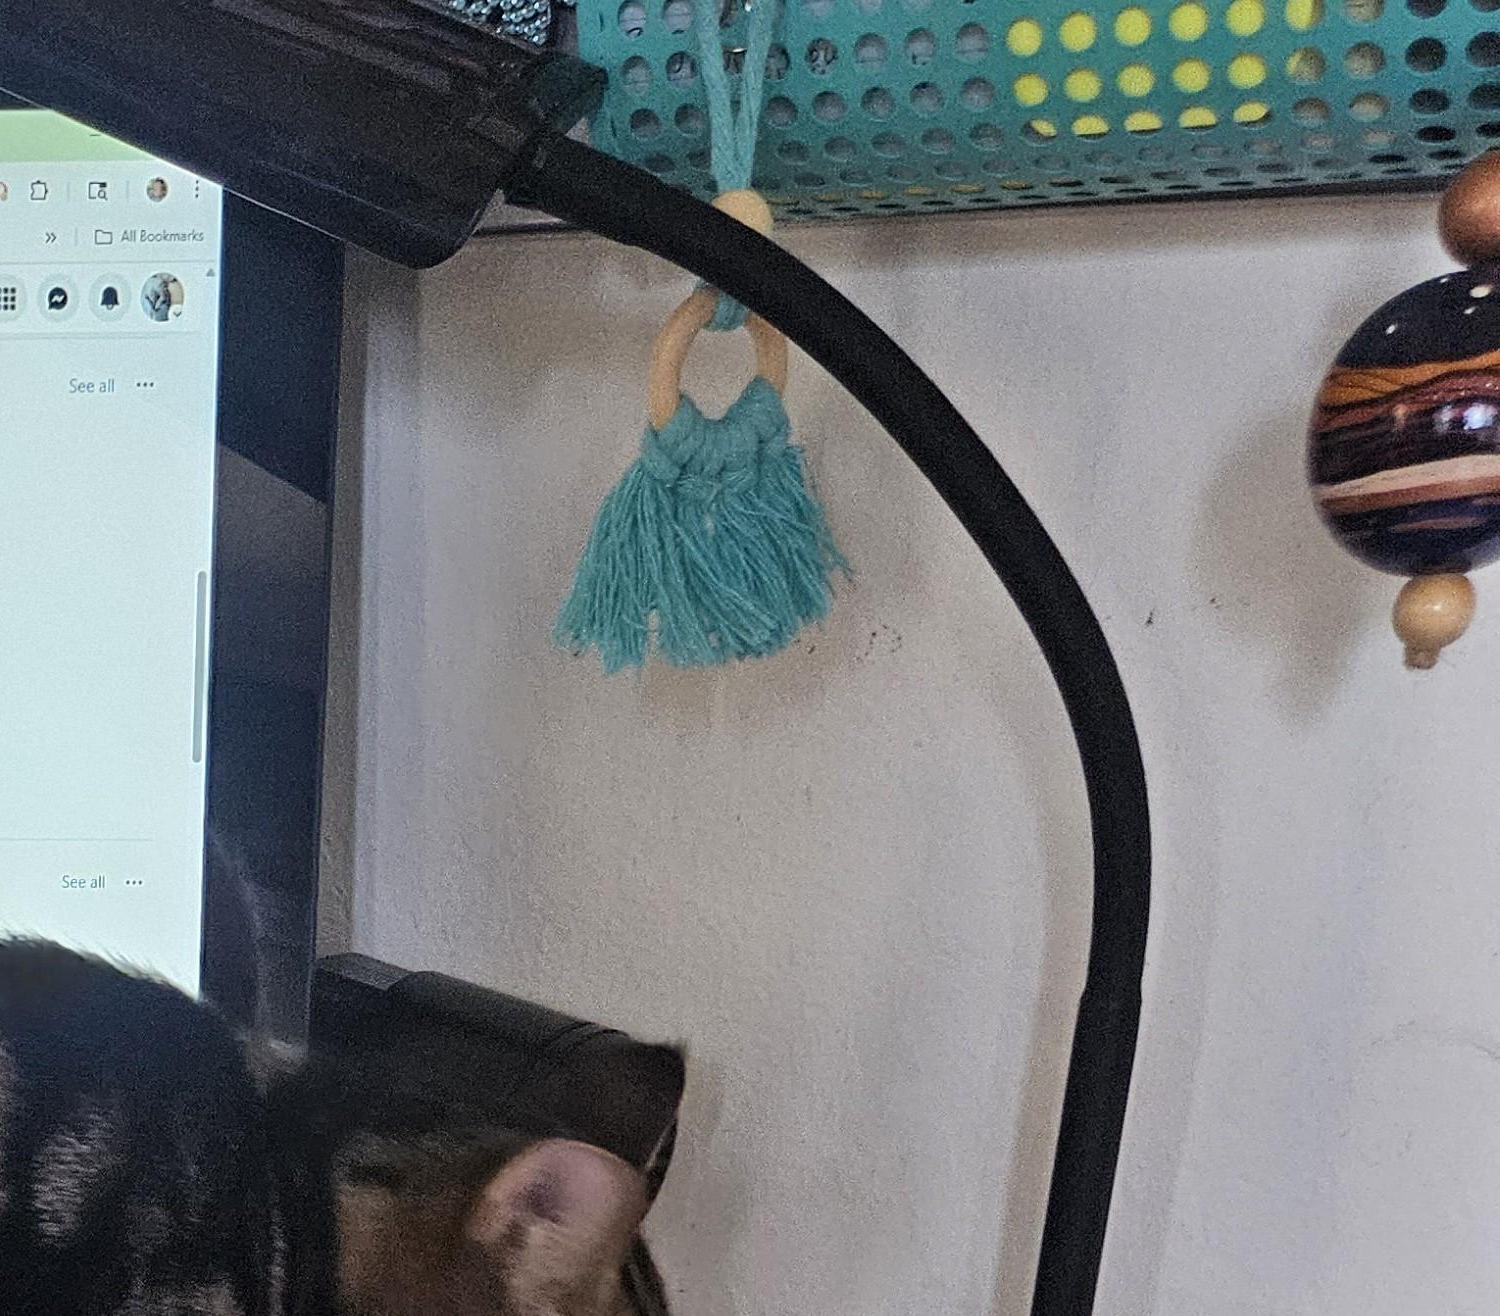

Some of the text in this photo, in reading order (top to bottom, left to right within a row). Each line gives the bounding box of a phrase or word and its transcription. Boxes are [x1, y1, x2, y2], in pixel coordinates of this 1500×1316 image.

[121, 229, 204, 243] All Bookmarks
[68, 377, 115, 393] See all
[61, 874, 105, 889] See all
